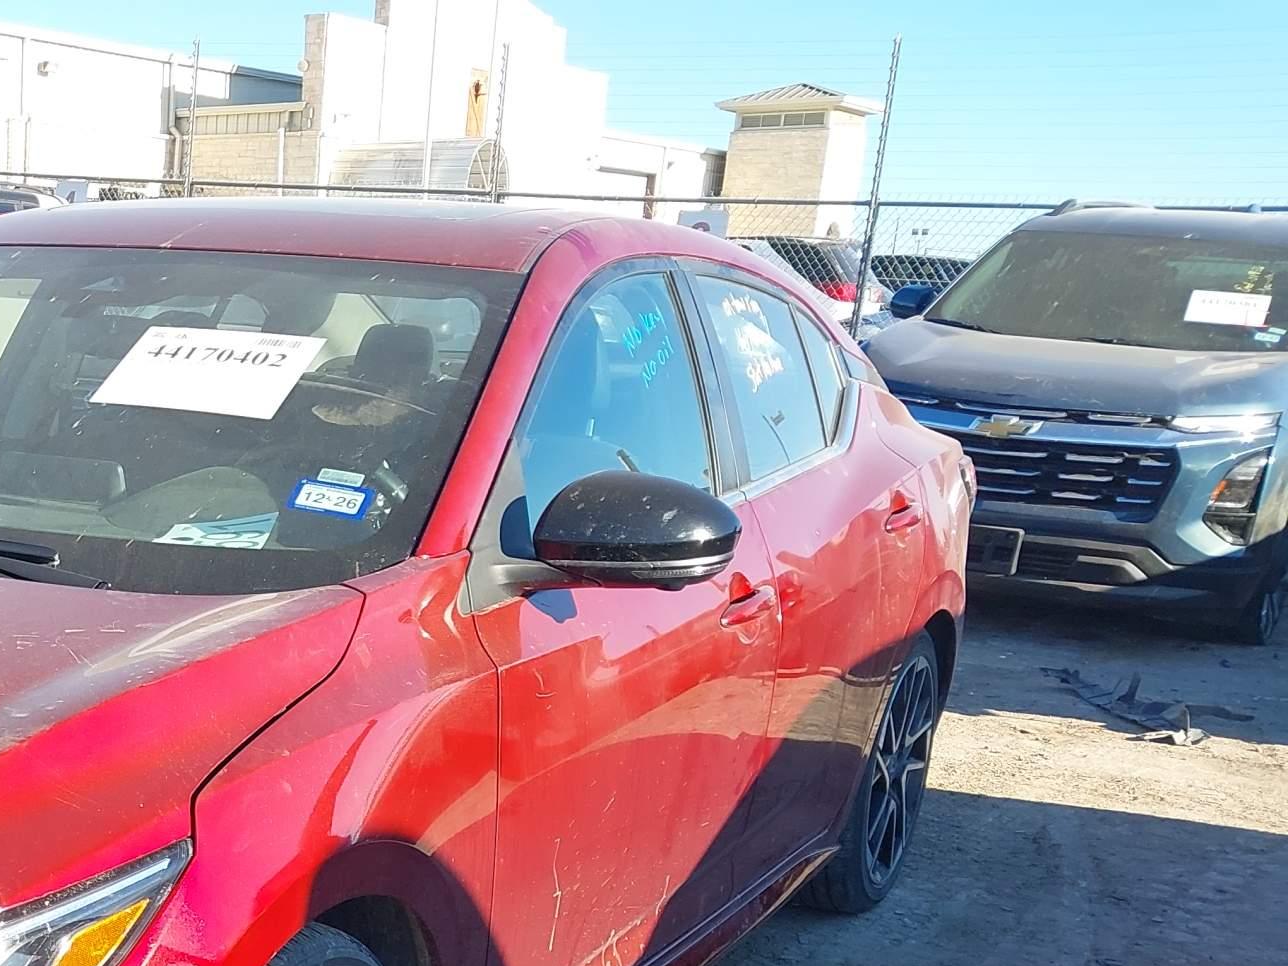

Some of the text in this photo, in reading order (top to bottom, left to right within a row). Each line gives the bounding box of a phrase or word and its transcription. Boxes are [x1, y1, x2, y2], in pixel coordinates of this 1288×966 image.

[146, 344, 289, 368] 44170402
[303, 491, 359, 510] 12 26
